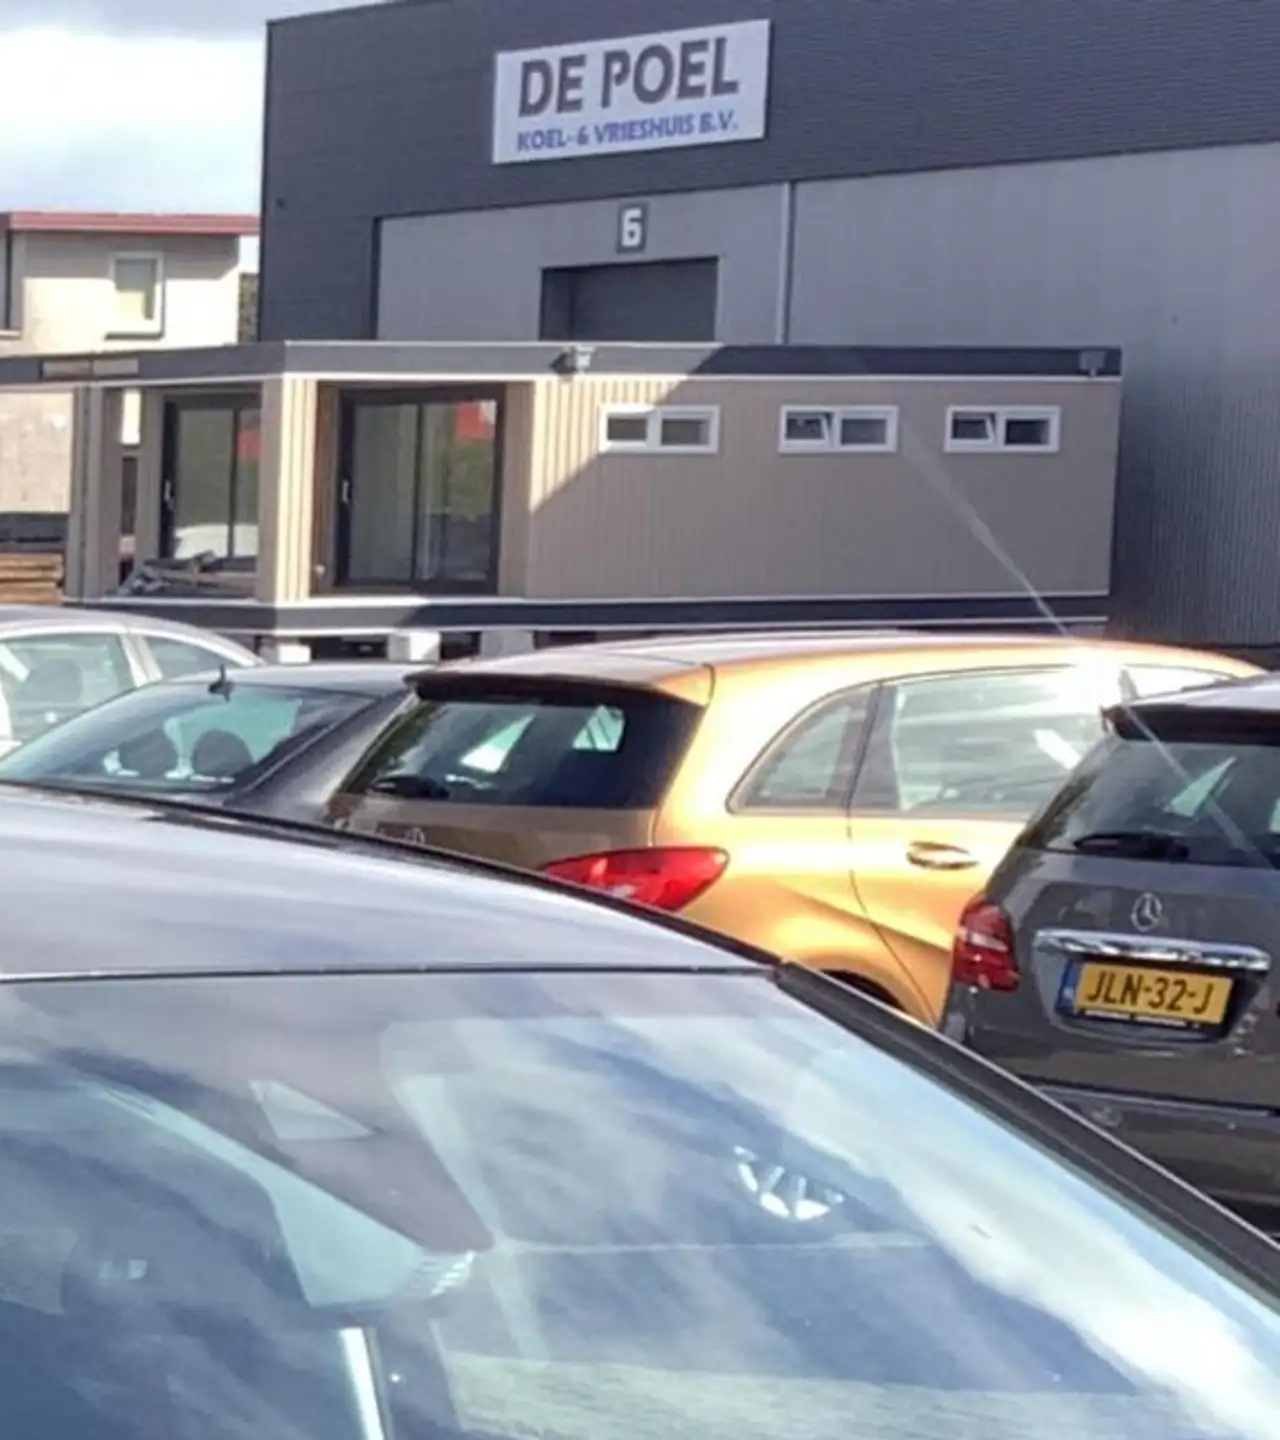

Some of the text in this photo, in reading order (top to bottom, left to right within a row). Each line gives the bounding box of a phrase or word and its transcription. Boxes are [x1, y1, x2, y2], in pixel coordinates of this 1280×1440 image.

[518, 37, 739, 118] DE POEL
[594, 113, 693, 144] VRIESHUIS
[698, 108, 739, 134] B.V.
[622, 207, 642, 247] 6
[1086, 970, 1215, 1015] JLN-32-J
